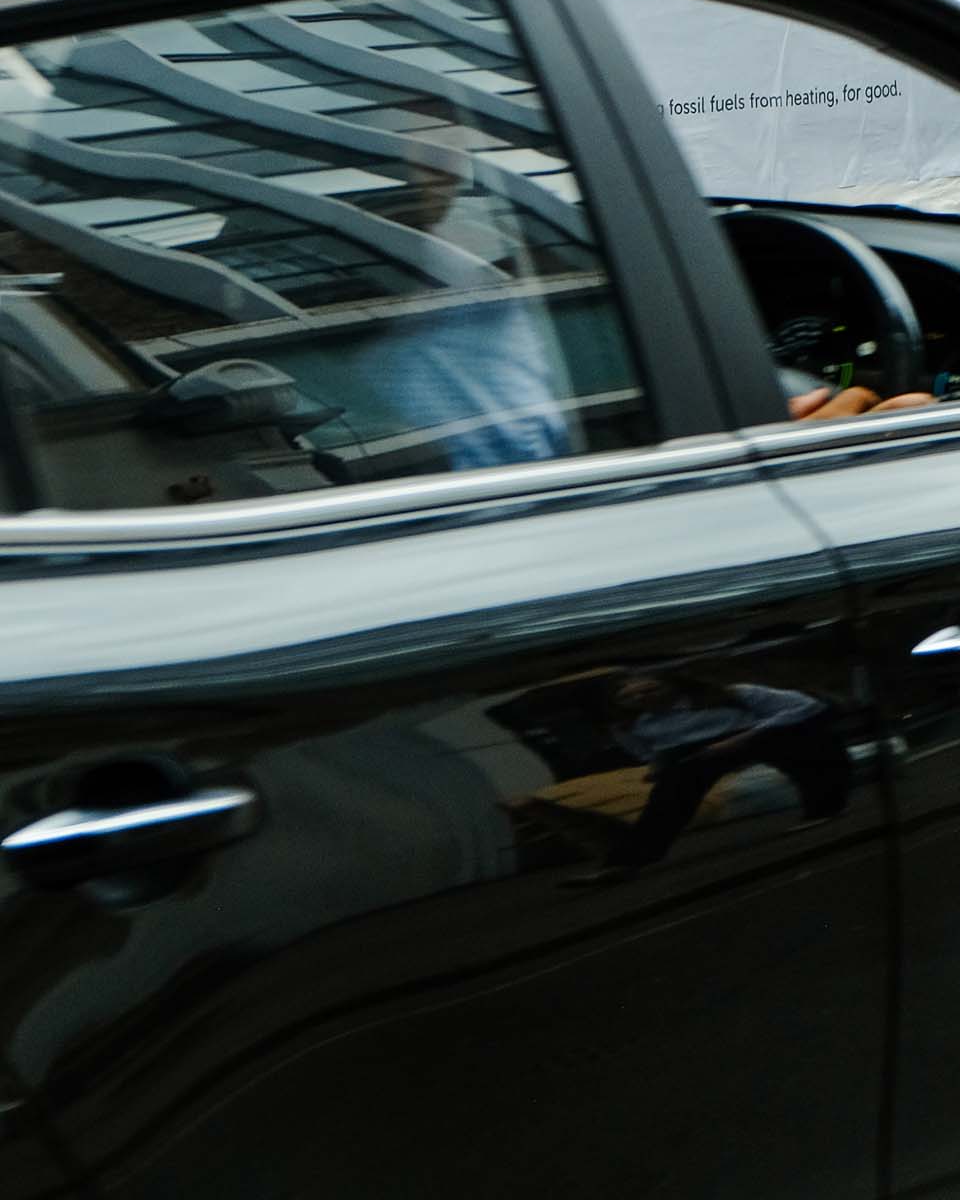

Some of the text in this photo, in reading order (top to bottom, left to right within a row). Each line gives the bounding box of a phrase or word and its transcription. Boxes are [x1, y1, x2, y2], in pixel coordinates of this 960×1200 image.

[669, 97, 705, 115] fossil
[710, 94, 745, 113] fuels
[750, 92, 783, 109] from
[786, 87, 839, 108] heating,
[842, 84, 862, 102] for
[865, 80, 902, 104] good.
